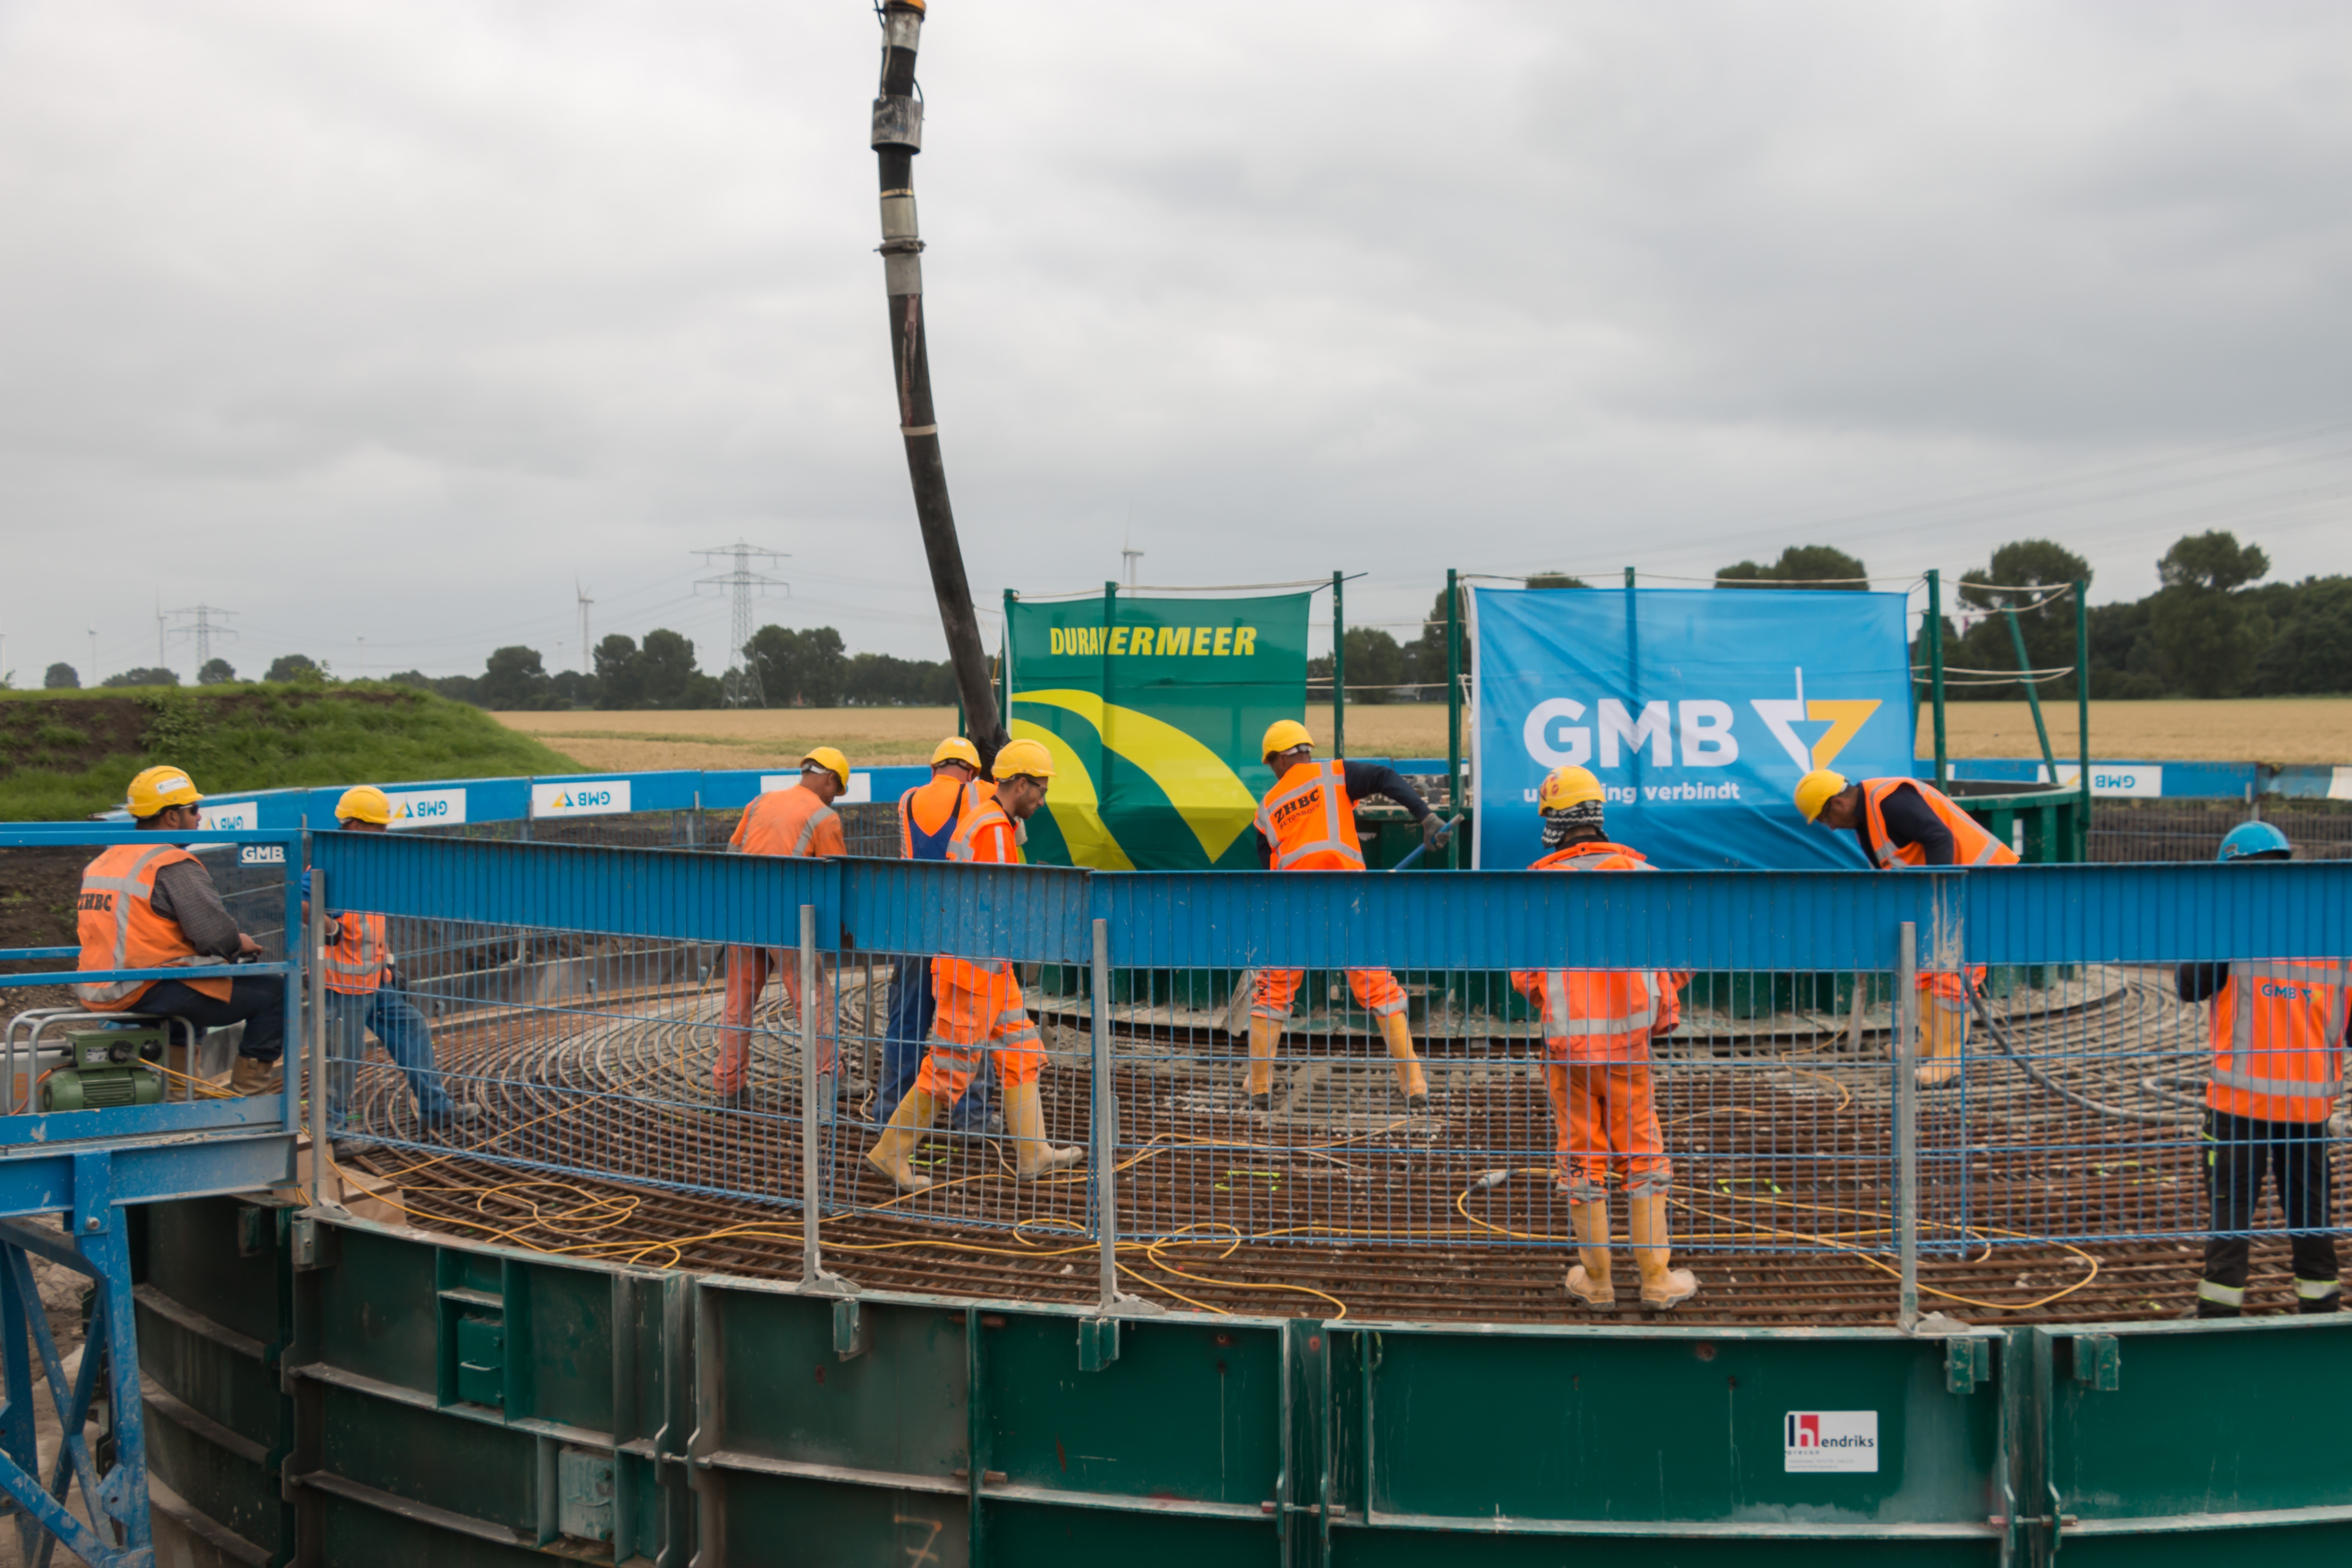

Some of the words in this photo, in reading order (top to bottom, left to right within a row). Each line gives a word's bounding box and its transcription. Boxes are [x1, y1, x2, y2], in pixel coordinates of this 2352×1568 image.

[1523, 697, 1739, 768] GMB
[2095, 775, 2135, 788] GMB
[577, 790, 611, 806] GMB
[1644, 782, 1740, 800] verbindt
[417, 800, 448, 817] GMB
[1274, 789, 1319, 824] ZHBC
[241, 846, 286, 860] GMB
[2261, 984, 2296, 999] GMB
